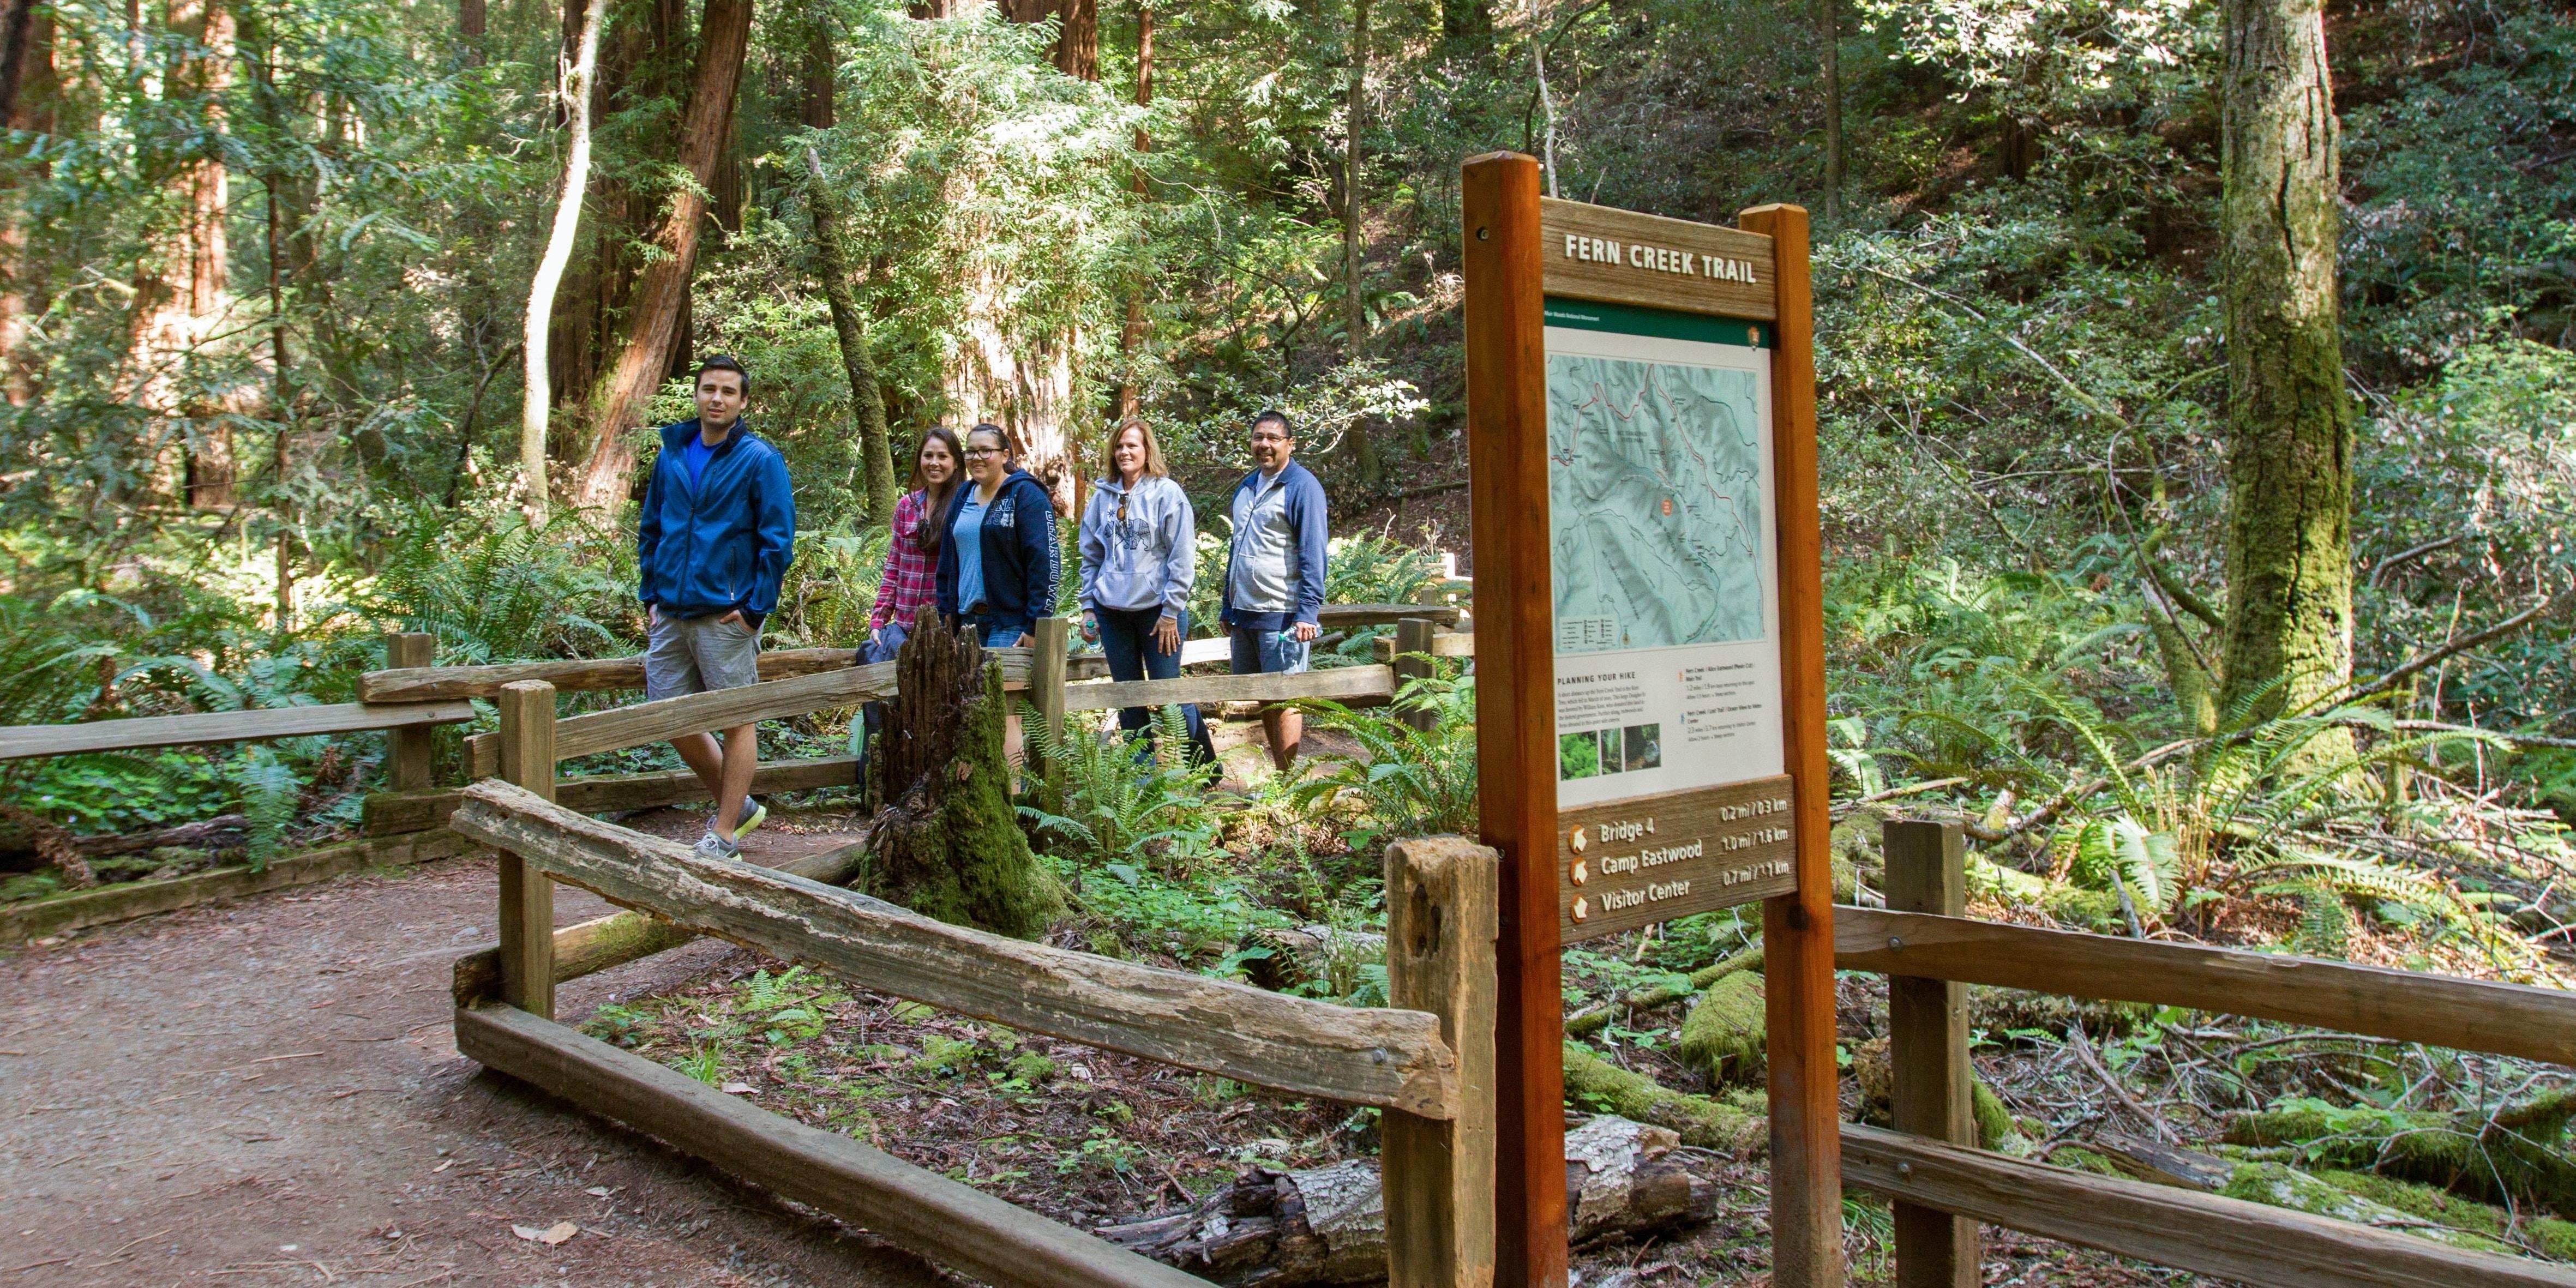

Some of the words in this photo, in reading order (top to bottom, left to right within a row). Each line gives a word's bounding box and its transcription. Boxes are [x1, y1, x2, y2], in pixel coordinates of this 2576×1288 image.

[1565, 233, 1620, 264] FERN
[1629, 244, 1694, 274] CREEK
[1701, 255, 1756, 283] TRAIL
[1558, 675, 1595, 685] PLANNING
[1598, 673, 1617, 682] YOUR
[1720, 805, 1736, 821] 0.2
[1737, 803, 1750, 818] mi
[1772, 798, 1787, 812] km
[1598, 821, 1643, 842] Bridge
[1646, 817, 1655, 834] 4
[1721, 836, 1737, 851] 1.0
[1738, 832, 1750, 848] mi
[1757, 829, 1773, 845] 1.6
[1773, 827, 1788, 841] km
[1601, 856, 1638, 875] Camp
[1641, 839, 1702, 868] Eastwood
[1721, 870, 1738, 886] 0.7
[1739, 865, 1751, 882] mi
[1773, 860, 1789, 875] km
[1600, 888, 1646, 911] Visitor
[1648, 881, 1690, 902] Center
